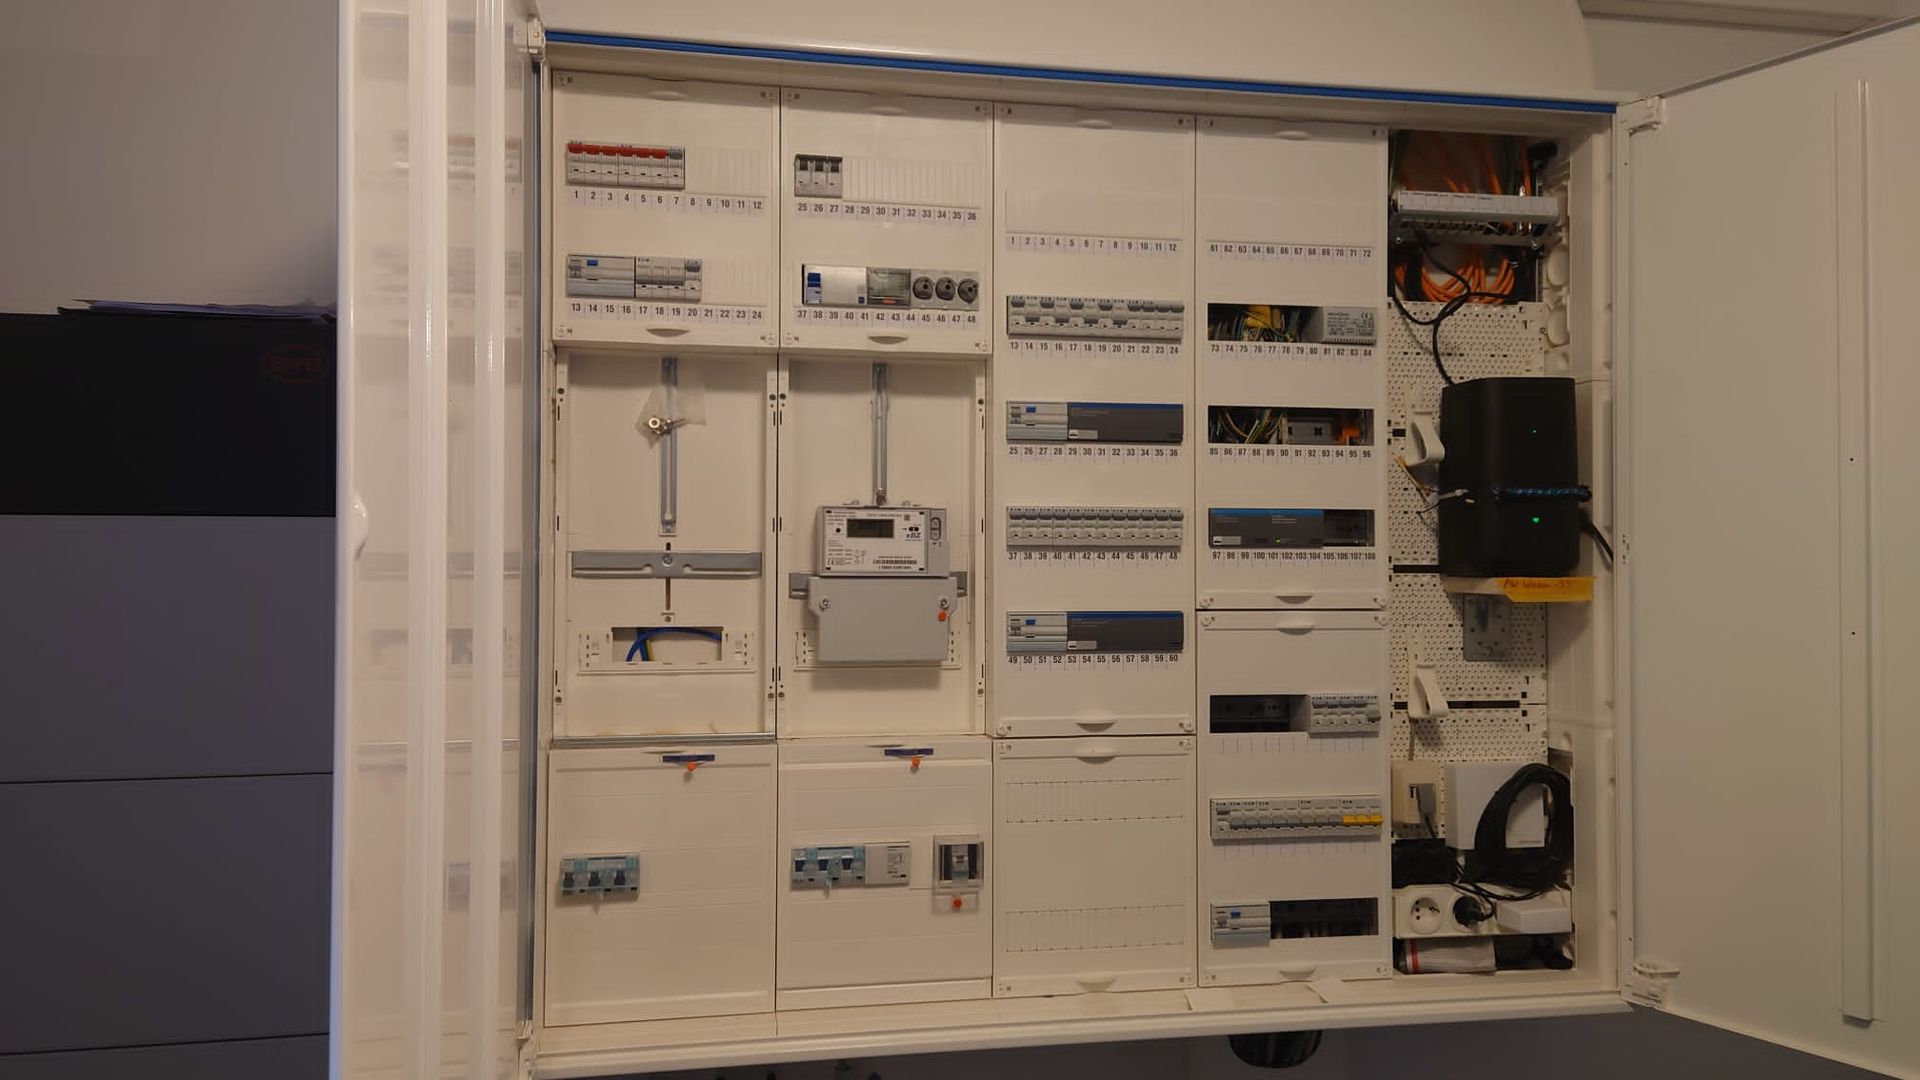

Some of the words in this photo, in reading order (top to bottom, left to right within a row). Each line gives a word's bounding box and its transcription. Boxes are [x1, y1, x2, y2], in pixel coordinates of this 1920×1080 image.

[574, 190, 578, 199] 1
[591, 191, 596, 200] 2
[607, 192, 613, 201] 3
[624, 193, 630, 202] 4
[641, 194, 646, 203] 5
[657, 195, 663, 204] 6
[673, 196, 679, 205] 7
[690, 197, 695, 206] 8
[706, 198, 712, 207] 9
[720, 199, 730, 208] 10
[737, 200, 745, 209] 11
[753, 201, 762, 210] 12
[798, 203, 807, 211] 25
[814, 203, 823, 212] 26
[829, 204, 839, 213] 27
[845, 205, 854, 214] 28
[861, 206, 870, 215] 29
[876, 207, 885, 216] 30
[891, 208, 901, 216] 31
[907, 208, 916, 217] 32
[922, 209, 931, 218] 33
[937, 210, 947, 219] 34
[952, 211, 961, 220] 35
[967, 212, 977, 221] 36
[1011, 236, 1015, 244] 1
[1025, 236, 1030, 245] 2
[1040, 237, 1045, 246] 3
[1054, 238, 1060, 246] 4
[1069, 238, 1075, 247] 5
[1084, 239, 1090, 248] 6
[1098, 240, 1103, 249] 7
[1127, 241, 1133, 250] 9
[1140, 242, 1149, 251] 10
[1155, 242, 1162, 251] 11
[1168, 243, 1177, 252] 12
[571, 303, 581, 311] 13
[588, 303, 598, 312] 14
[605, 304, 615, 313] 15
[622, 305, 632, 314] 16
[638, 306, 648, 314] 17
[655, 306, 665, 315] 18
[671, 307, 681, 316] 19
[688, 308, 697, 317] 20
[704, 309, 713, 317] 21
[720, 309, 730, 318] 22
[737, 310, 746, 319] 23
[752, 311, 762, 319] 24
[798, 310, 807, 318] 37
[814, 310, 823, 319] 38
[829, 311, 838, 320] 39
[845, 311, 854, 320] 40
[860, 312, 869, 321] 41
[875, 312, 885, 321] 42
[891, 313, 900, 322] 43
[906, 313, 916, 322] 44
[921, 314, 931, 322] 45
[936, 314, 946, 323] 46
[951, 314, 961, 323] 47
[966, 315, 976, 324] 48
[1009, 341, 1019, 350] 13
[1025, 342, 1034, 350] 14
[1040, 342, 1049, 351] 15
[1054, 342, 1063, 351] 16
[1069, 343, 1078, 352] 17
[1083, 343, 1093, 352] 18
[1098, 344, 1107, 352] 19
[1112, 344, 1122, 353] 20
[1127, 344, 1136, 353] 21
[1141, 345, 1150, 354] 22
[1155, 346, 1165, 354] 23
[1169, 346, 1179, 355] 24
[1009, 446, 1018, 455] 25
[1024, 446, 1034, 455] 26
[1039, 447, 1048, 456] 27
[1053, 447, 1062, 456] 28
[1068, 447, 1078, 456] 29
[1083, 447, 1092, 456] 30
[1097, 448, 1106, 456] 31
[1111, 448, 1121, 456] 32
[1126, 448, 1136, 457] 33
[1140, 448, 1150, 457] 34
[1154, 448, 1164, 457] 35
[1169, 448, 1178, 457] 36
[1008, 552, 1017, 560] 37
[1023, 552, 1032, 560] 38
[1038, 552, 1047, 560] 39
[1053, 552, 1062, 560] 40
[1067, 552, 1076, 560] 41
[1082, 552, 1091, 560] 42
[1097, 552, 1106, 560] 43
[1111, 552, 1120, 560] 44
[1125, 552, 1135, 560] 45
[1140, 552, 1149, 560] 46
[1154, 552, 1163, 560] 47
[1168, 552, 1178, 560] 48
[1008, 656, 1017, 665] 49
[1023, 656, 1032, 664] 50
[1038, 655, 1047, 664] 51
[1053, 655, 1062, 664] 52
[1067, 655, 1076, 664] 53
[1082, 655, 1092, 664] 54
[1096, 655, 1106, 663] 55
[1111, 654, 1121, 663] 56
[1126, 654, 1135, 663] 57
[1140, 654, 1150, 663] 58
[1154, 654, 1164, 663] 59
[1169, 654, 1178, 662] 60
